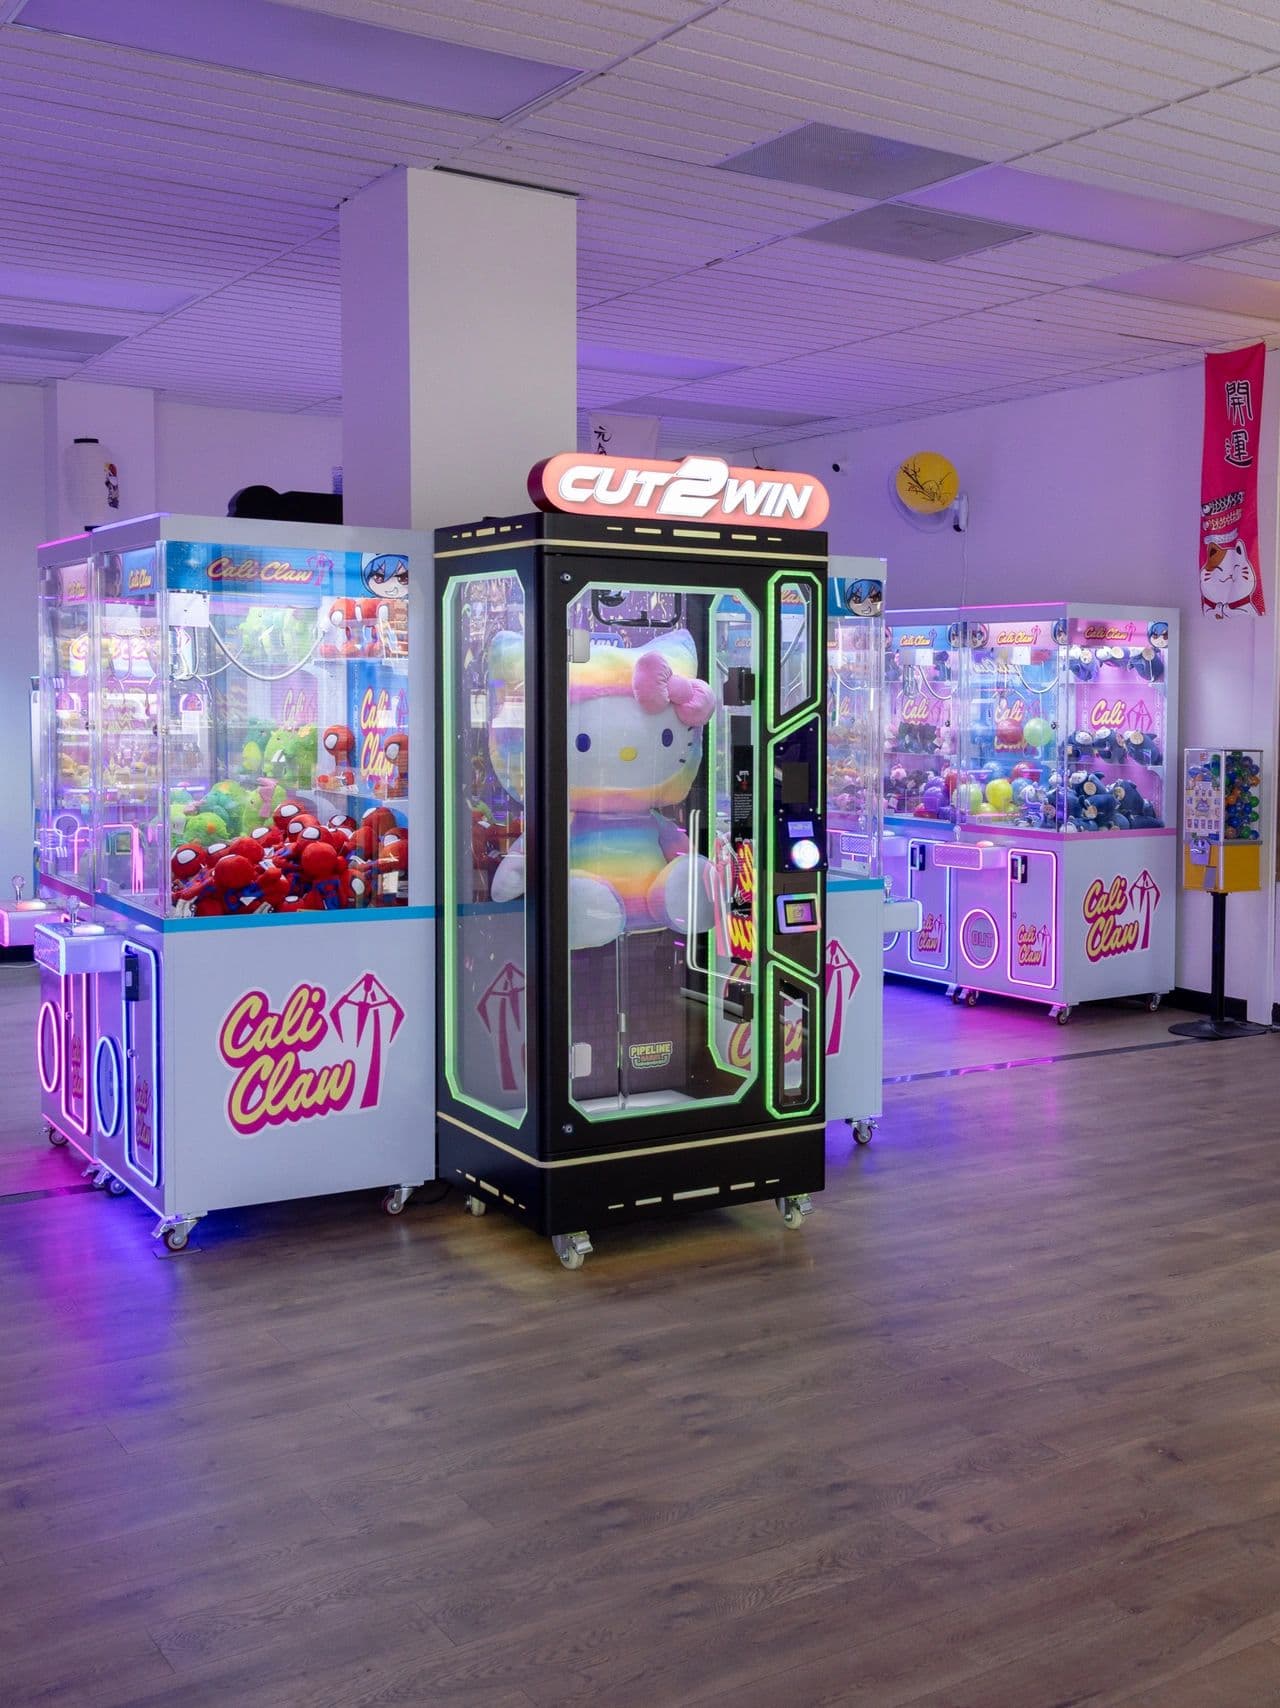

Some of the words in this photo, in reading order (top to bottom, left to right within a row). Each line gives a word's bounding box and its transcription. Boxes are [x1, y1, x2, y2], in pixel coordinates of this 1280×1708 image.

[1225, 380, 1254, 468] 開運
[1090, 699, 1126, 727] Cali
[1083, 875, 1128, 924] Cali
[917, 932, 938, 952] Claw
[1017, 924, 1037, 945] Cali
[1086, 914, 1139, 962] Claw
[1018, 944, 1042, 966] Claw
[219, 983, 329, 1068] Cali
[631, 1043, 671, 1056] PIPELINE
[228, 1051, 356, 1135] Claw
